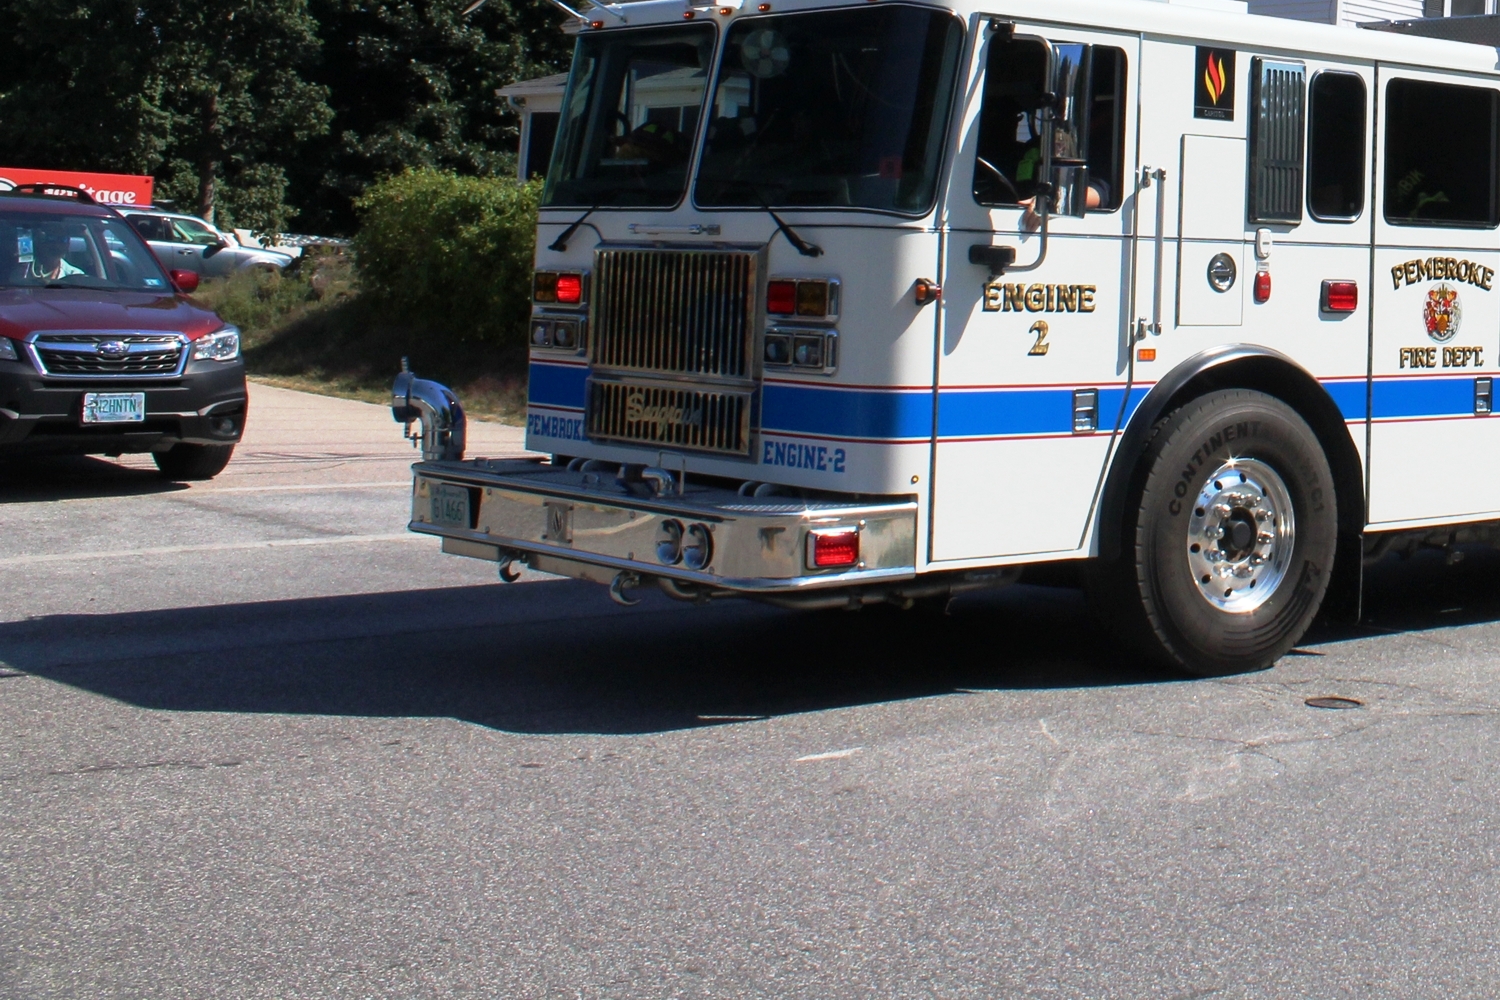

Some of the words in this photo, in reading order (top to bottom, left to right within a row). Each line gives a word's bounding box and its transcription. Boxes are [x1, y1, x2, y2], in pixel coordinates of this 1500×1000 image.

[1390, 256, 1495, 292] PEMBROKE
[981, 282, 1097, 313] ENGINE
[1027, 319, 1050, 356] 2
[1399, 347, 1437, 369] FIRE
[1442, 346, 1484, 368] DEPT.
[762, 440, 846, 473] ENGINE-2
